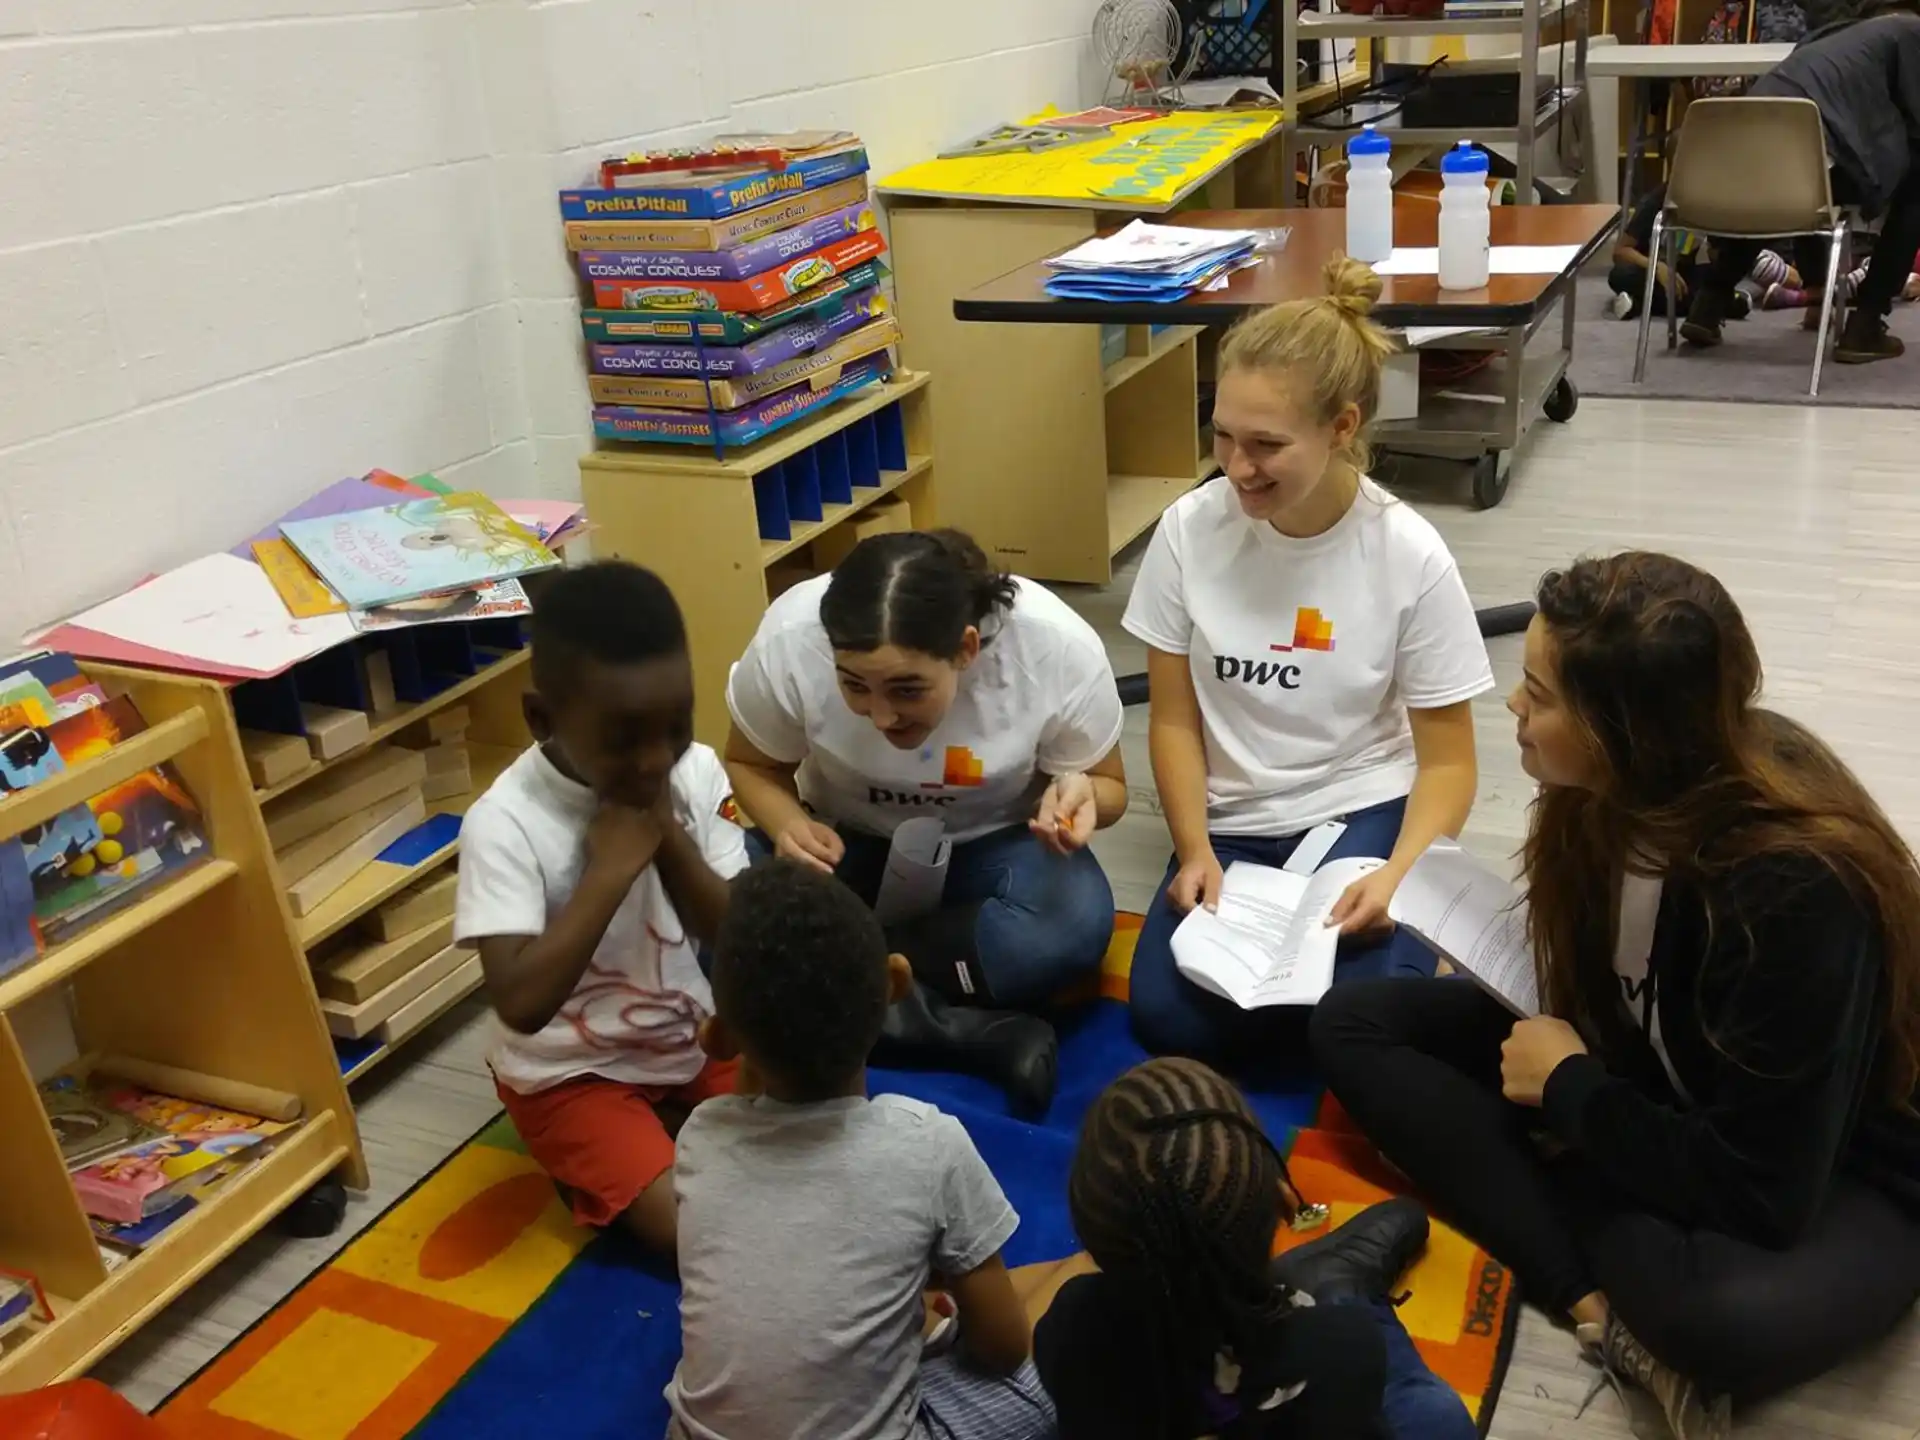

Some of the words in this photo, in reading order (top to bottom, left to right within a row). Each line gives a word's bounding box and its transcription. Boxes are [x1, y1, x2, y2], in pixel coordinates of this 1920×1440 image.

[729, 179, 768, 207] Prefix
[767, 172, 804, 194] Pitfall
[584, 197, 637, 213] Prefix
[637, 196, 688, 213] Pitfall
[620, 255, 648, 265] Prefix
[588, 265, 644, 276] COSMIC
[647, 265, 723, 277] CONQUEST
[602, 358, 658, 369] COSMIC
[1213, 655, 1301, 689] pwc
[867, 785, 957, 807] pwc
